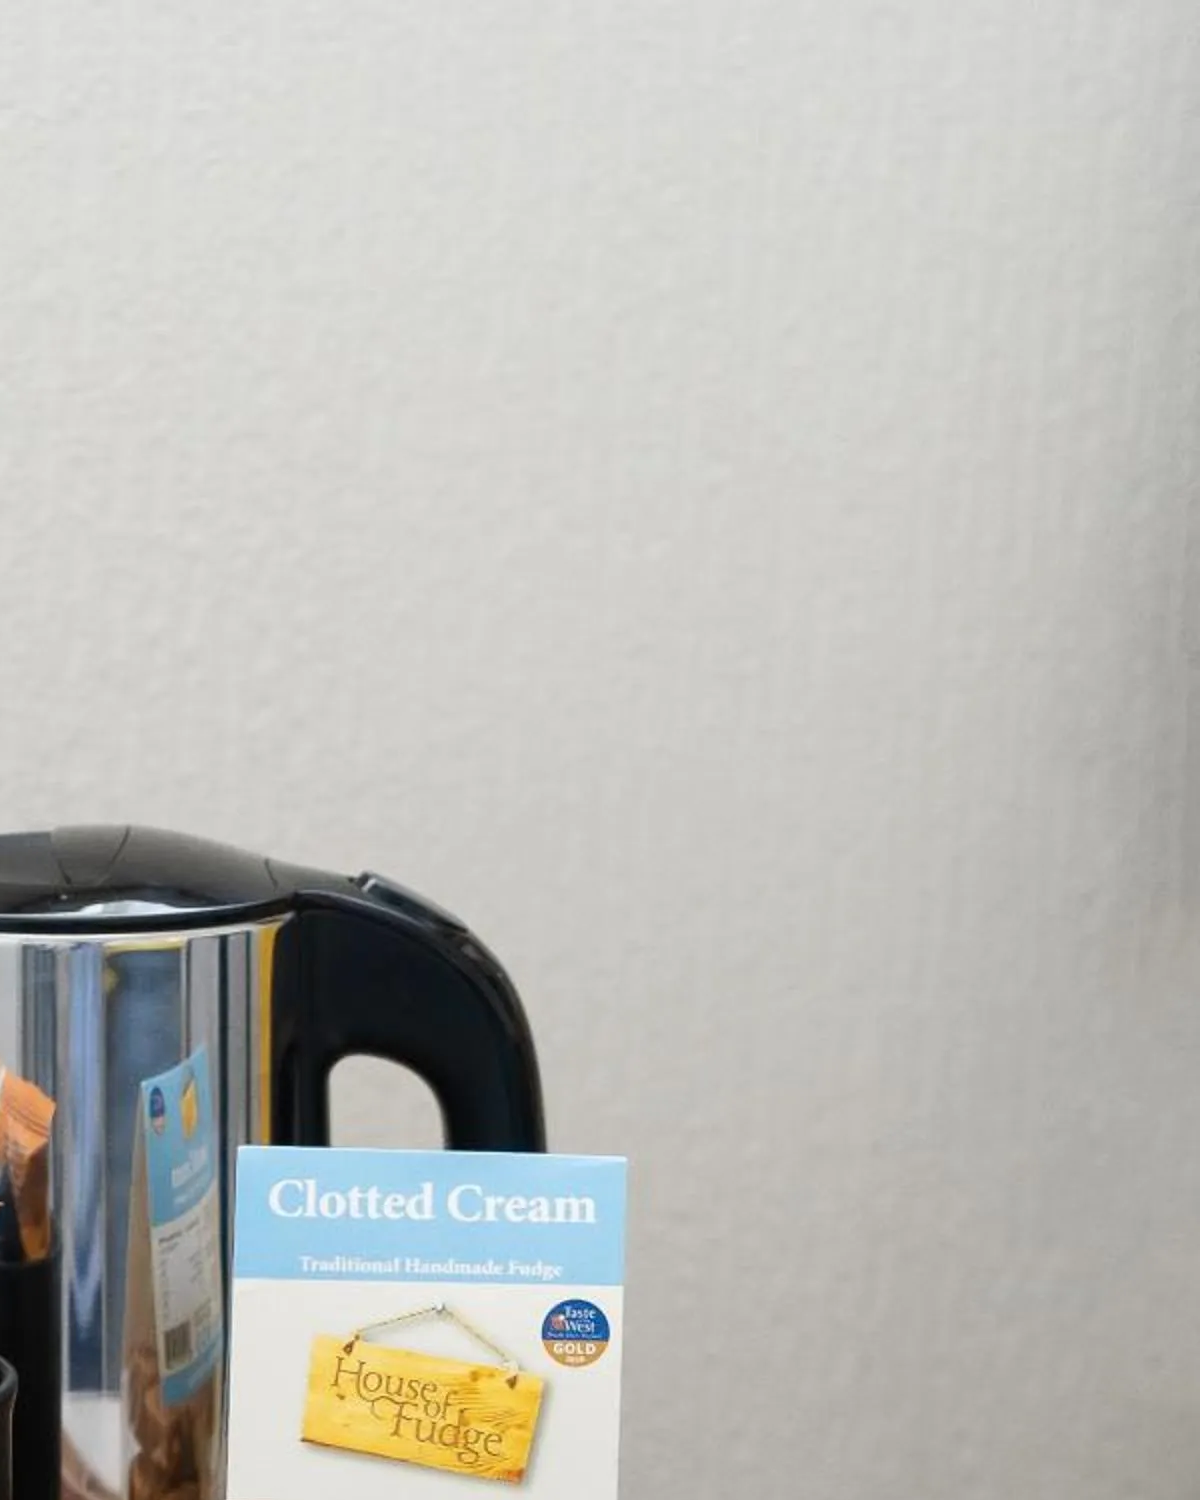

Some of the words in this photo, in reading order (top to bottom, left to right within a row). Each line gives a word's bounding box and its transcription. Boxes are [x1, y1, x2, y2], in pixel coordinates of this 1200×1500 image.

[268, 1179, 434, 1221] Clotted
[447, 1184, 596, 1223] Cream
[299, 1256, 400, 1274] Traditional
[404, 1258, 503, 1276] Handmade
[507, 1260, 563, 1278] Fudge
[563, 1305, 596, 1318] Taste
[564, 1319, 595, 1333] West
[553, 1343, 597, 1355] GOLD
[331, 1356, 439, 1404] House
[422, 1392, 456, 1421] of
[386, 1400, 504, 1465] Fudge
